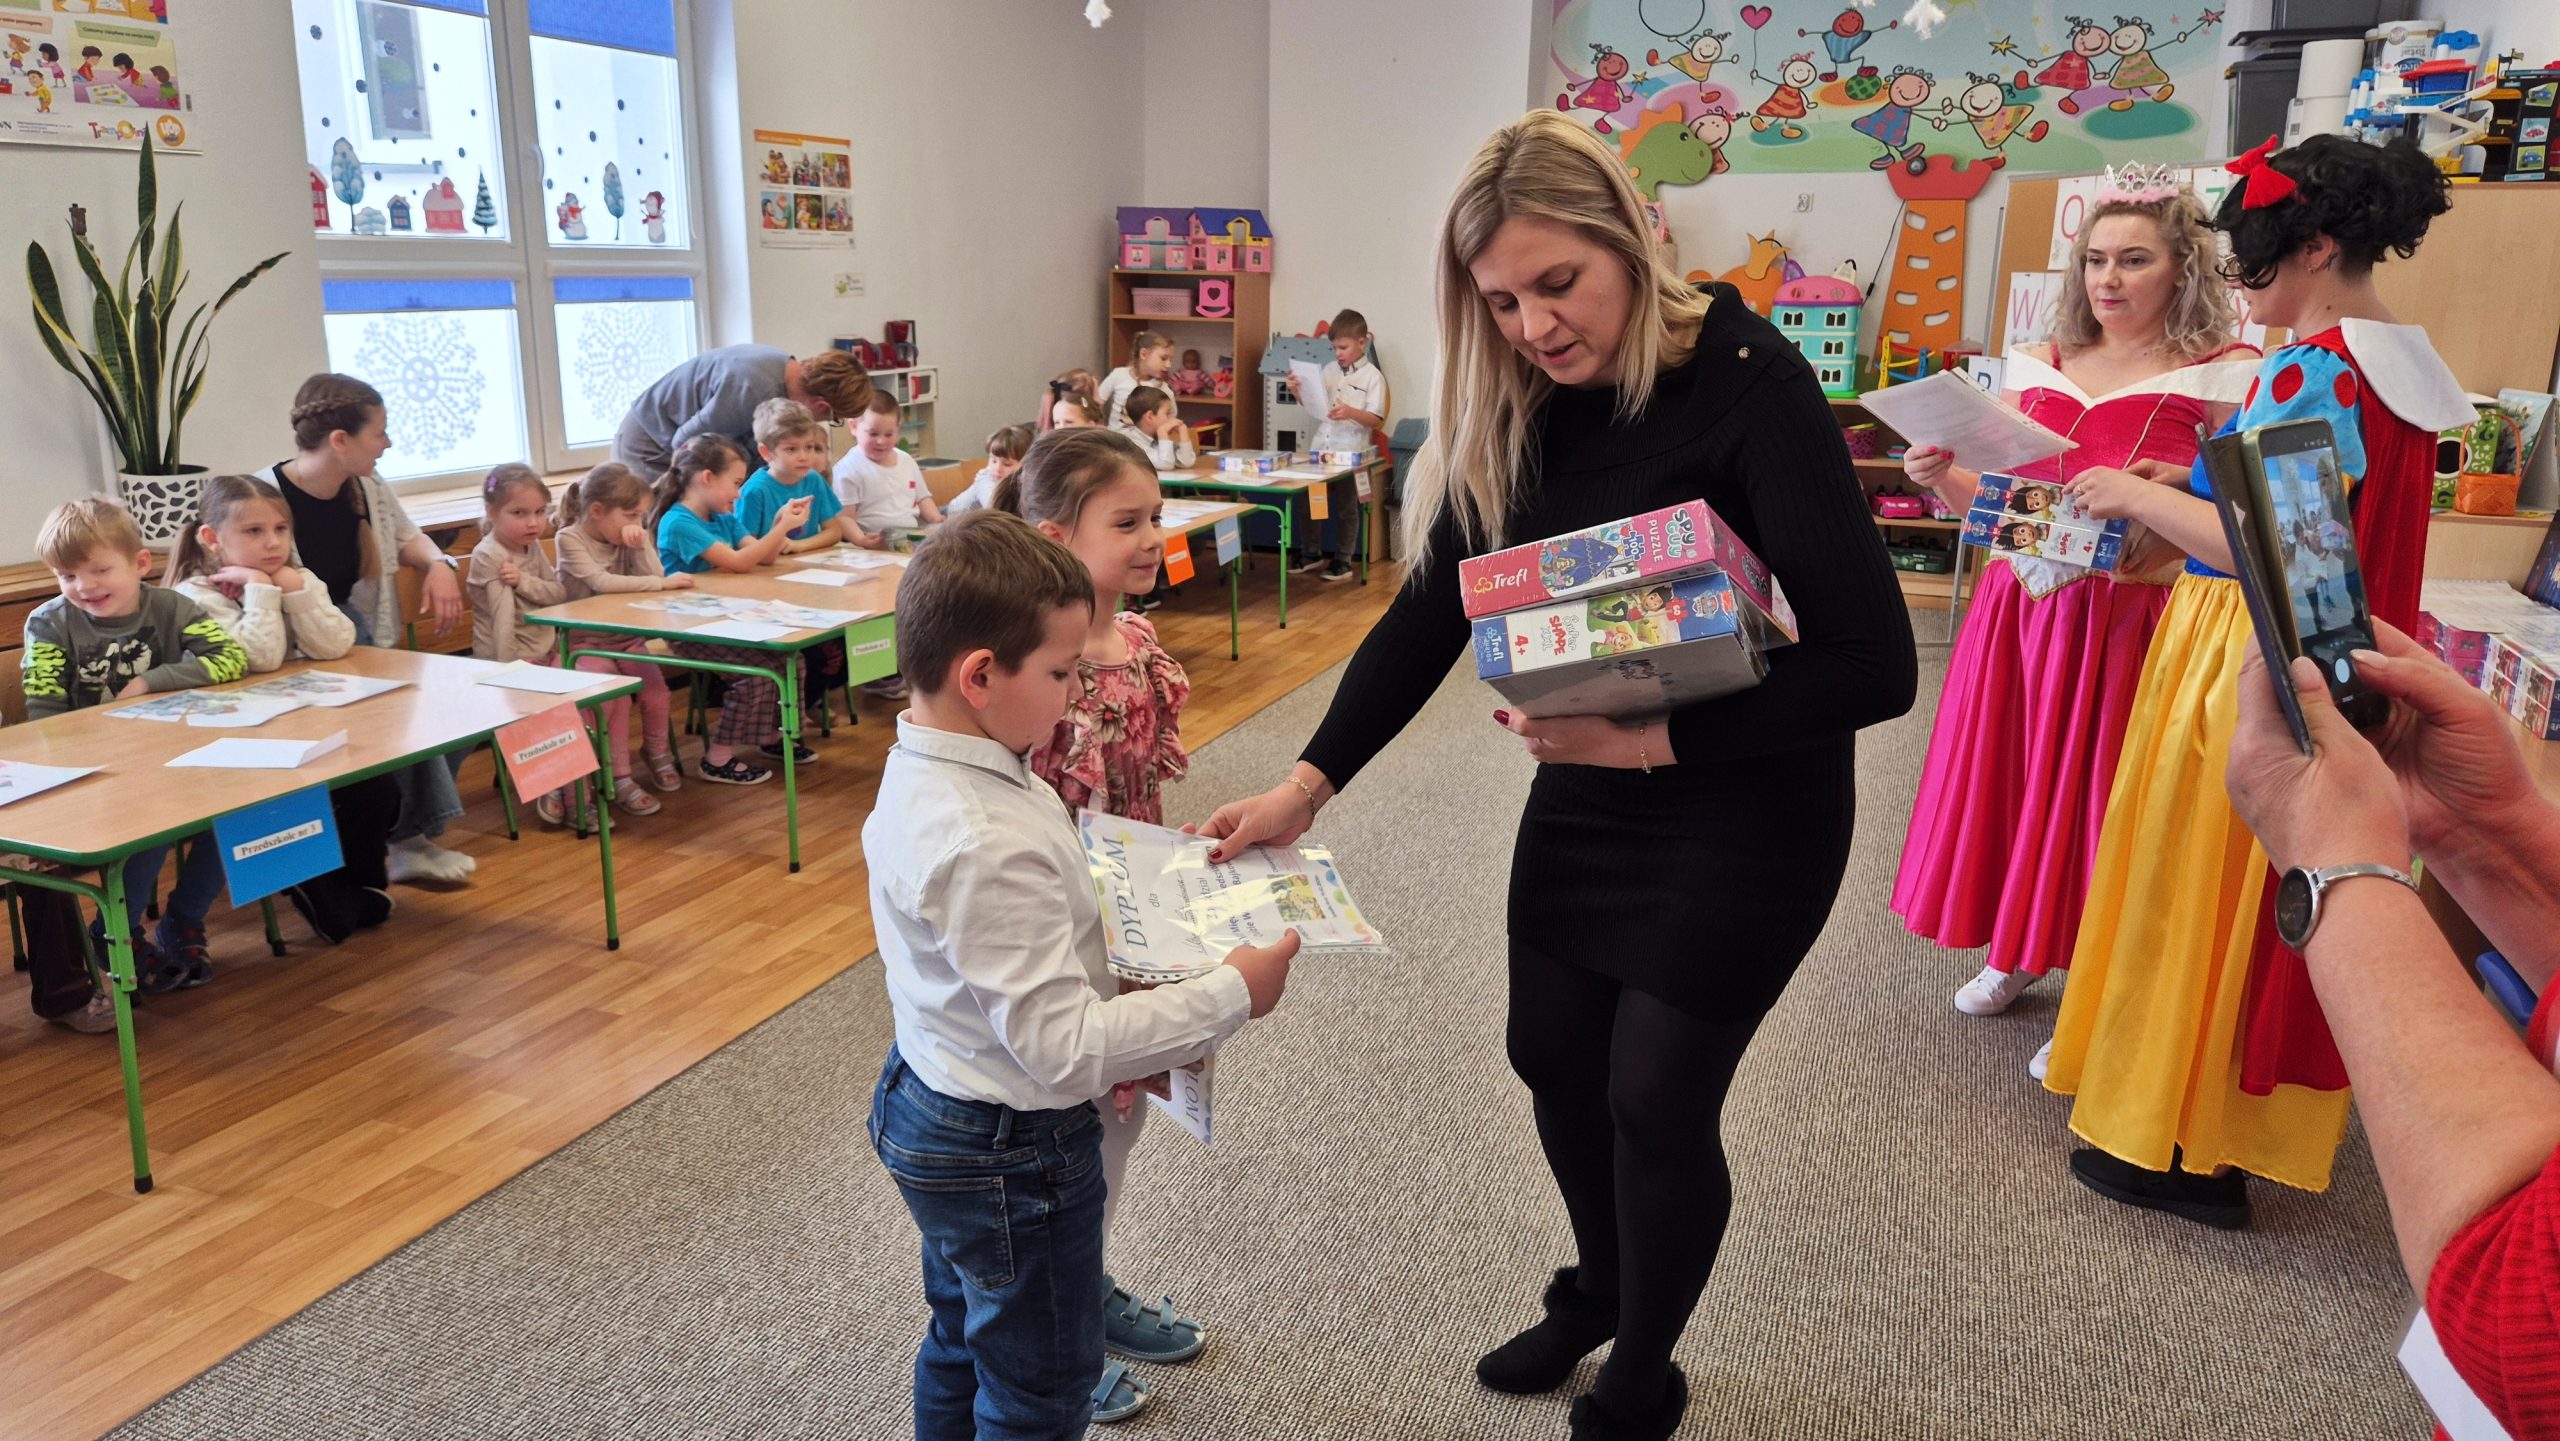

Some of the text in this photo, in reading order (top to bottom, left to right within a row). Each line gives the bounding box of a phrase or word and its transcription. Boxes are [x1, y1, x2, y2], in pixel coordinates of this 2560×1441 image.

[2061, 194, 2085, 241] Q
[2013, 288, 2041, 330] W
[1665, 520, 1682, 558] GUY
[1673, 507, 1696, 545] SPY
[1628, 537, 1640, 554] 100
[1648, 519, 1664, 562] PUZZLE
[1493, 567, 1528, 589] Trefl
[1672, 604, 1681, 615] 60
[1491, 635, 1504, 661] Trefl
[1514, 634, 1529, 655] 4+
[1549, 615, 1566, 656] SHAPE
[518, 740, 558, 760] Przedszkole
[241, 832, 296, 856] Przedszkole
[298, 828, 308, 837] nr
[1102, 835, 1149, 949] DYPLOM
[1149, 892, 1160, 908] dla
